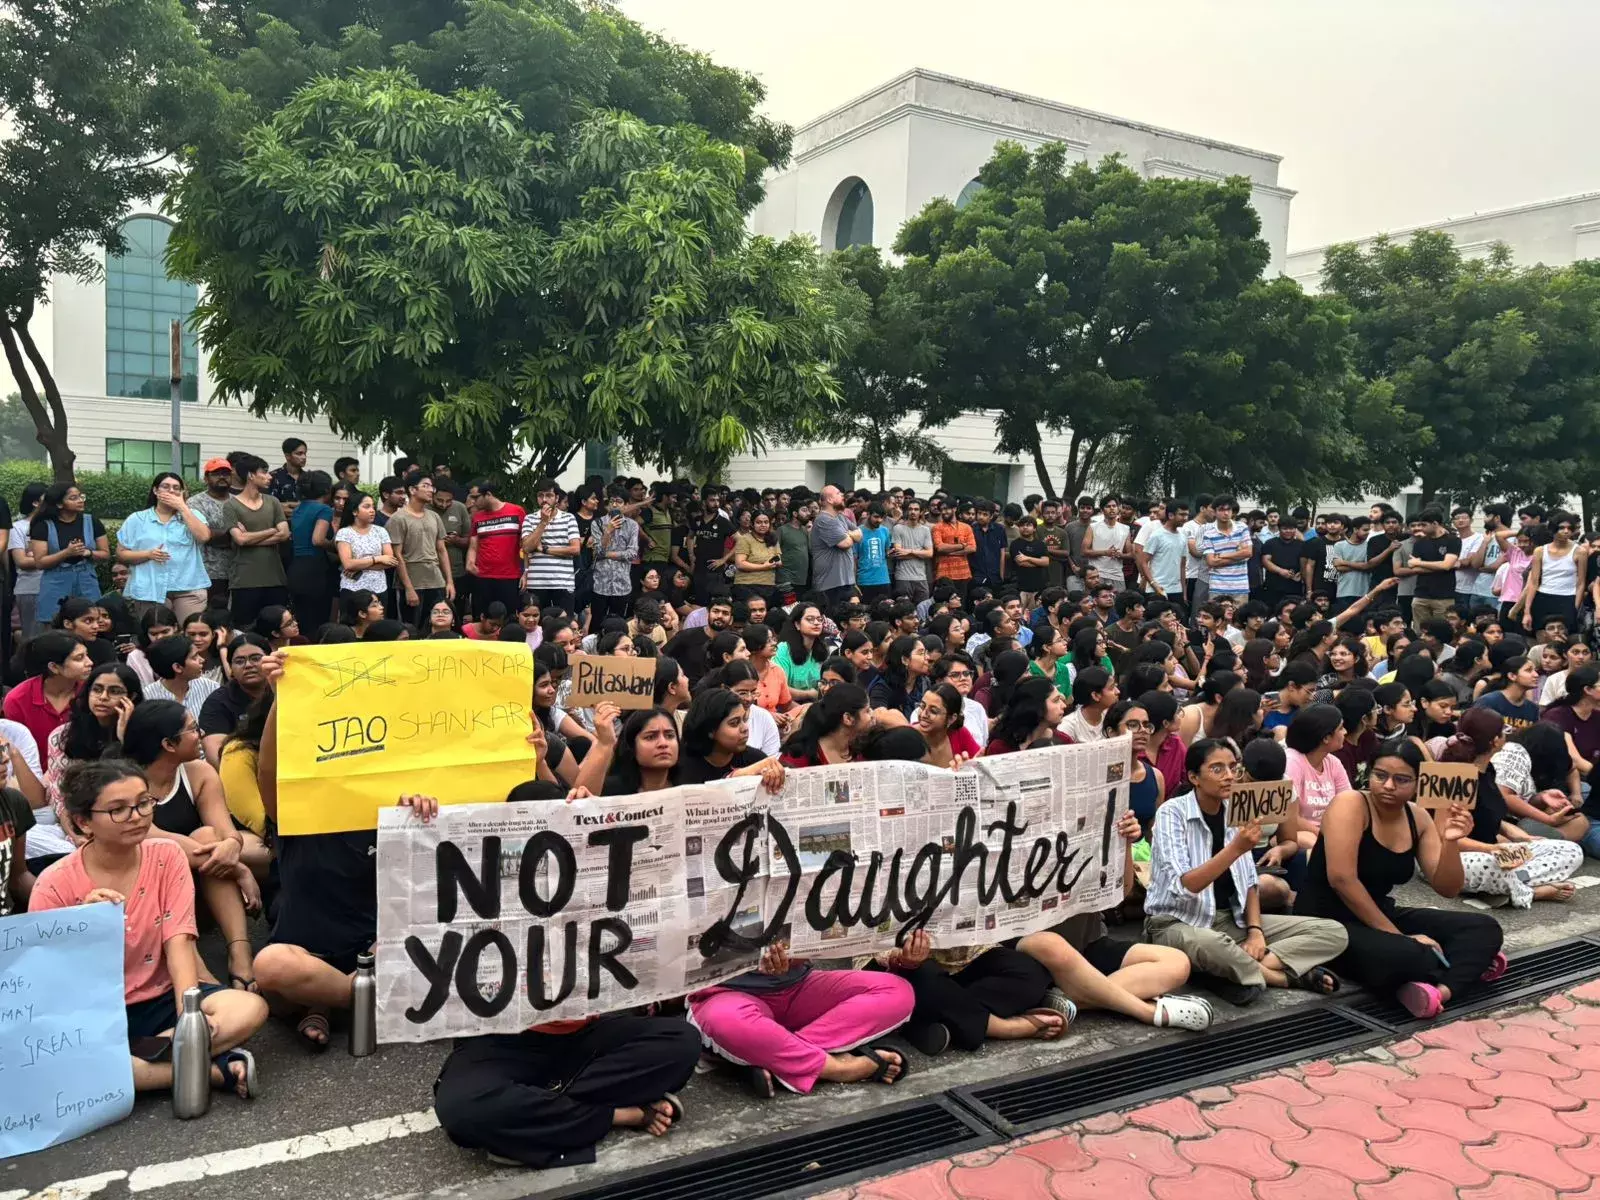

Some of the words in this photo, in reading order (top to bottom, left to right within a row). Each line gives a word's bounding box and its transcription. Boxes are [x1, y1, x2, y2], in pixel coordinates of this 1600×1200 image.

[408, 653, 534, 685] SHANKAR
[317, 715, 387, 753] JAO
[393, 701, 529, 740] SHANKAR
[573, 805, 664, 825] Text&Context
[686, 808, 709, 817] What
[712, 807, 719, 815] is
[436, 825, 650, 923] NOT
[36, 919, 89, 939] WORD
[404, 917, 639, 1024] YOUR
[20, 1027, 84, 1068] GREAT
